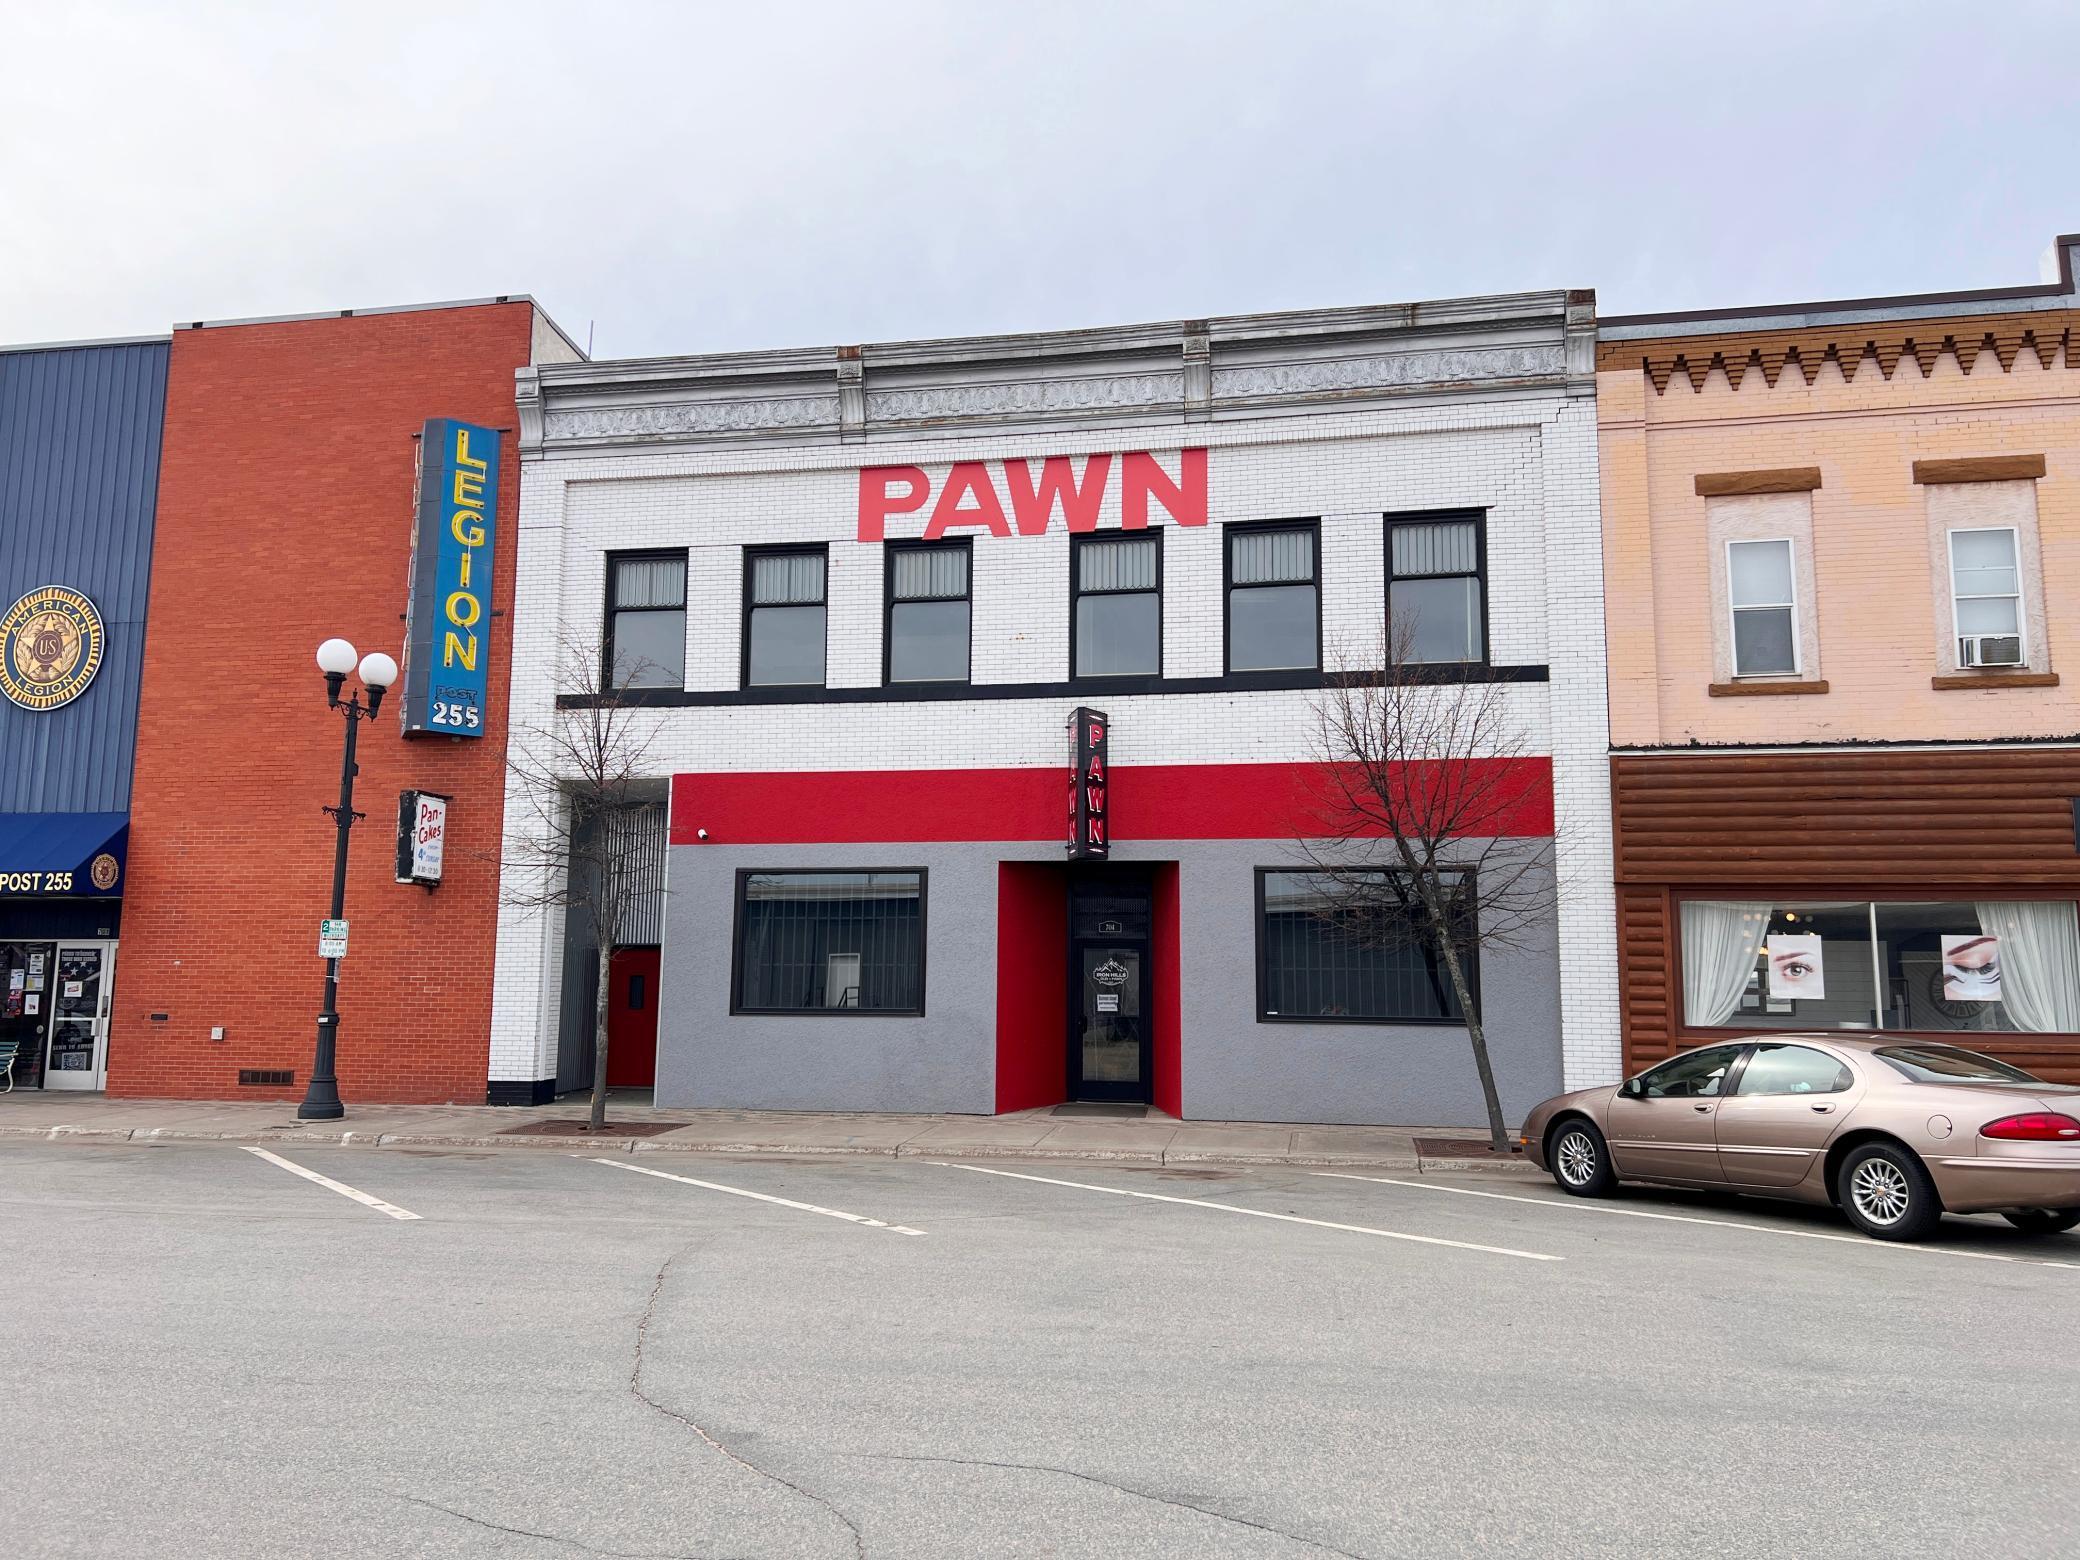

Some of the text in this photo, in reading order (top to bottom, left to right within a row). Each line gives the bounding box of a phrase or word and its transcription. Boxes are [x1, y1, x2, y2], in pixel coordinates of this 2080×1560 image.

[857, 447, 1208, 543] PAWN
[443, 429, 487, 671] LEGION
[11, 600, 89, 637] AMERICAN
[15, 674, 74, 696] LEGION
[435, 685, 478, 700] POST
[432, 701, 480, 729] 255
[1087, 724, 1105, 845] PAWN
[420, 804, 442, 825] Pan-
[418, 825, 441, 845] Cakes
[0, 872, 73, 892] POST 255
[322, 923, 329, 931] 2
